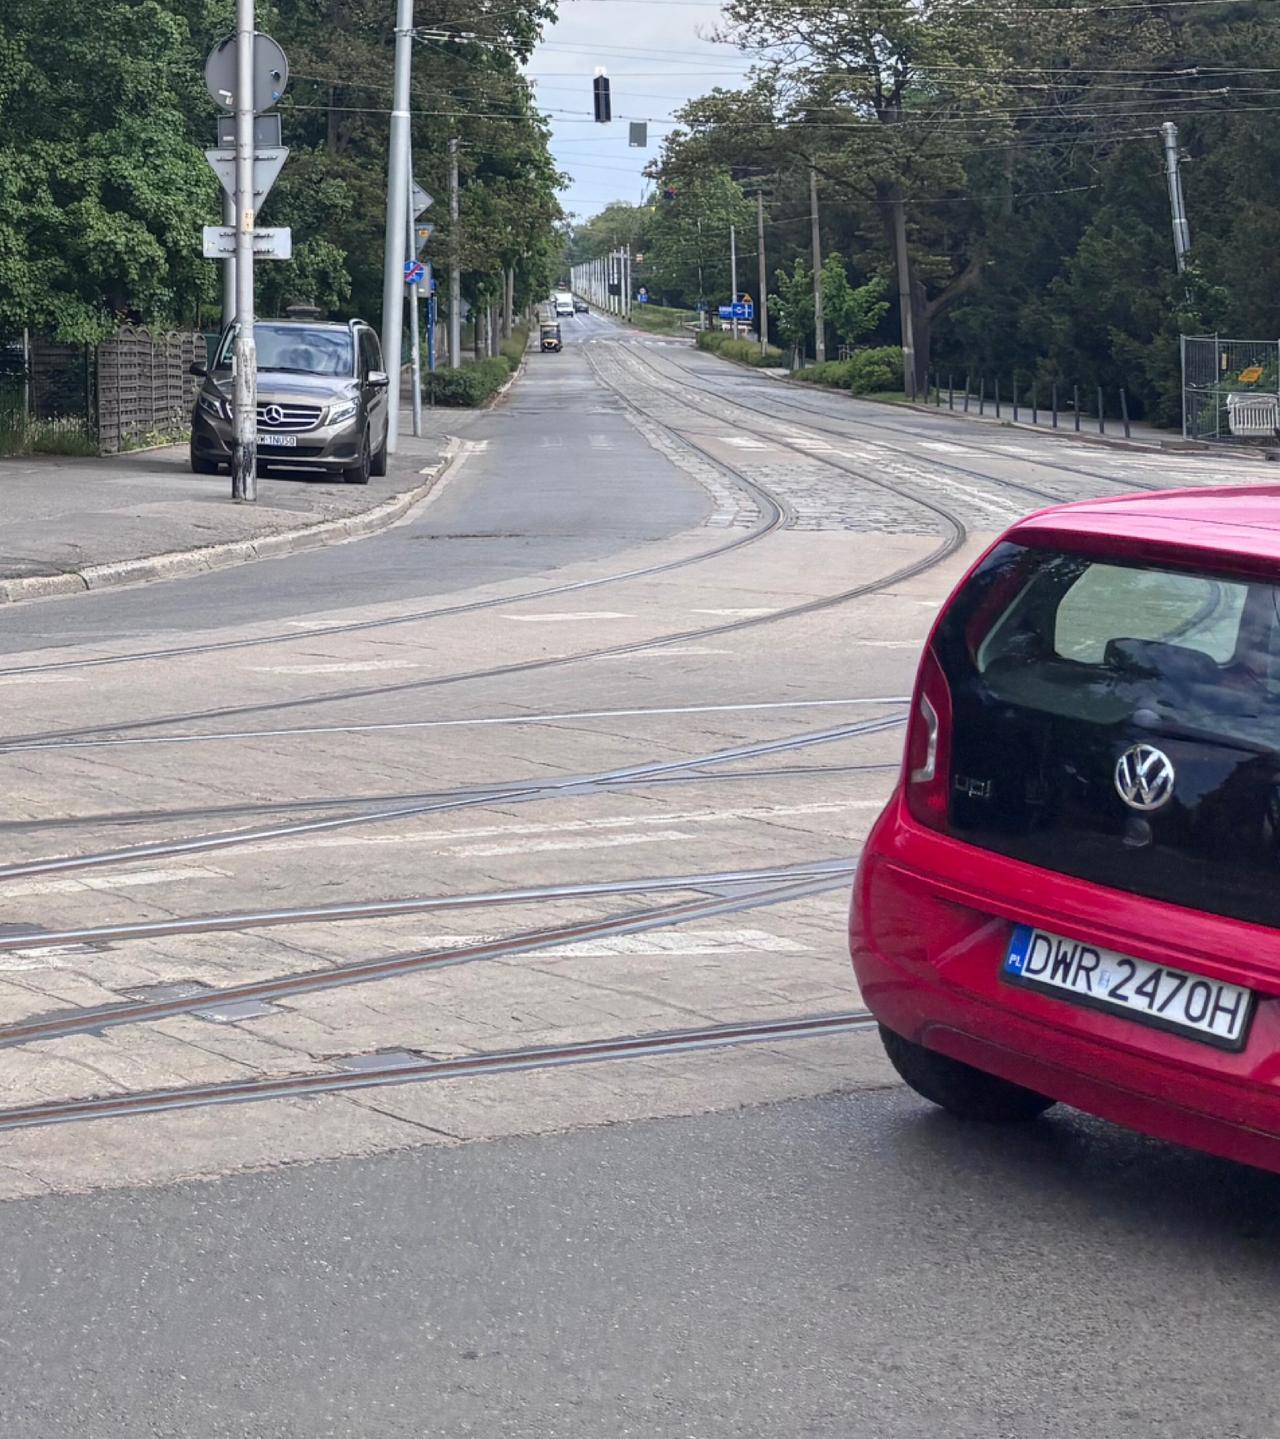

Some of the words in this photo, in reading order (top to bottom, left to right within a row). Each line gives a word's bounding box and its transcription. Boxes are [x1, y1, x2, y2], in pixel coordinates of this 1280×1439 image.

[1008, 953, 1022, 968] PL
[1025, 933, 1101, 992] DWR
[1108, 958, 1244, 1035] 2470H
